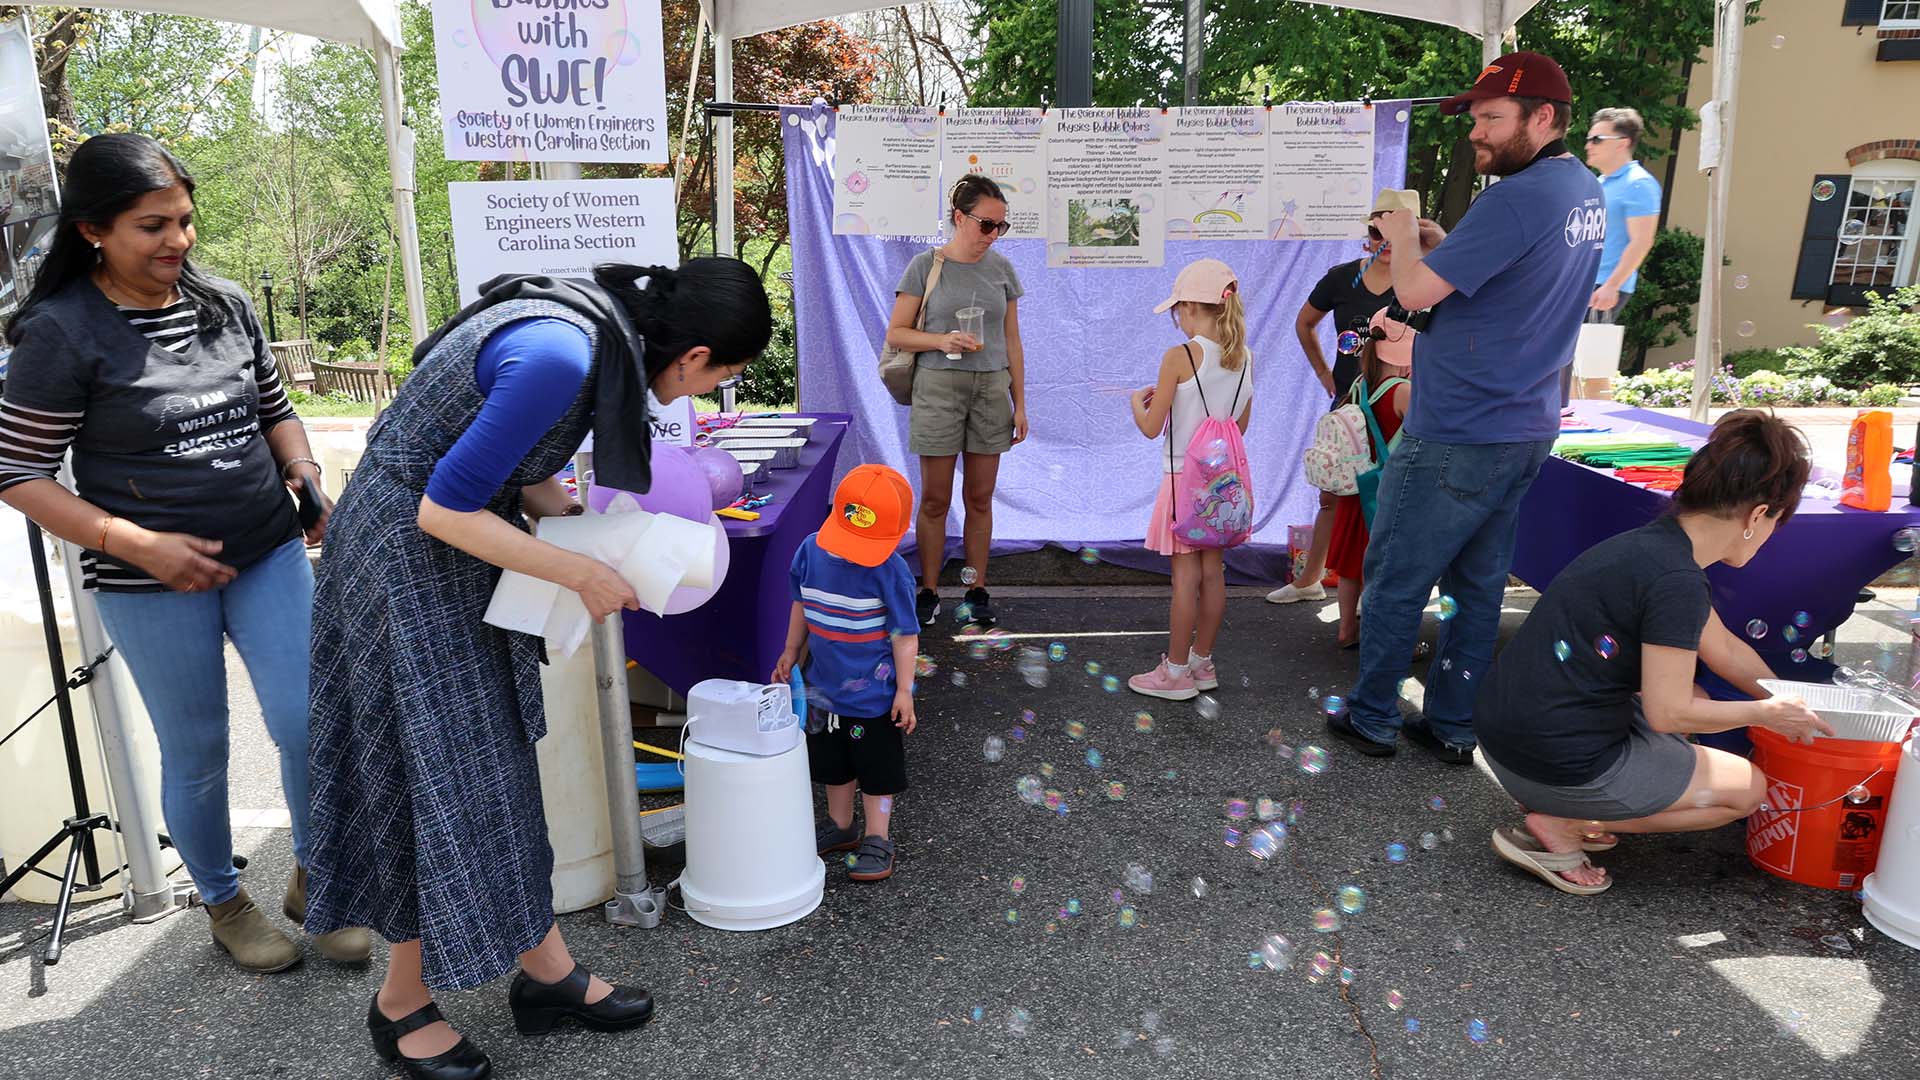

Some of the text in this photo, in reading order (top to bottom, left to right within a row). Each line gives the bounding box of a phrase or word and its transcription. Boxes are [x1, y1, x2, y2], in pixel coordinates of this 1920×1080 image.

[518, 12, 588, 48] with
[501, 53, 607, 110] SWE!
[852, 105, 865, 114] The
[866, 106, 888, 114] Science
[957, 108, 970, 117] The
[970, 108, 994, 117] Science
[1060, 108, 1150, 120] The Science of Bubbles
[1180, 108, 1192, 116] The
[1226, 107, 1254, 116] Bubbles
[1286, 106, 1298, 115] The
[1333, 106, 1360, 114] Bubbles
[457, 110, 655, 133] Society of Women Engineers
[1058, 121, 1150, 133] Physics Bubble Colors
[1177, 117, 1254, 128] Physics Bubble Colors
[1296, 117, 1320, 126] Bubble
[465, 131, 650, 151] Western Carolina Section
[487, 192, 640, 212] Society of Women
[485, 213, 646, 234] Engineers Western
[498, 234, 636, 252] Carolina Section
[191, 390, 228, 409] I AM
[178, 406, 248, 433] WHAT AN
